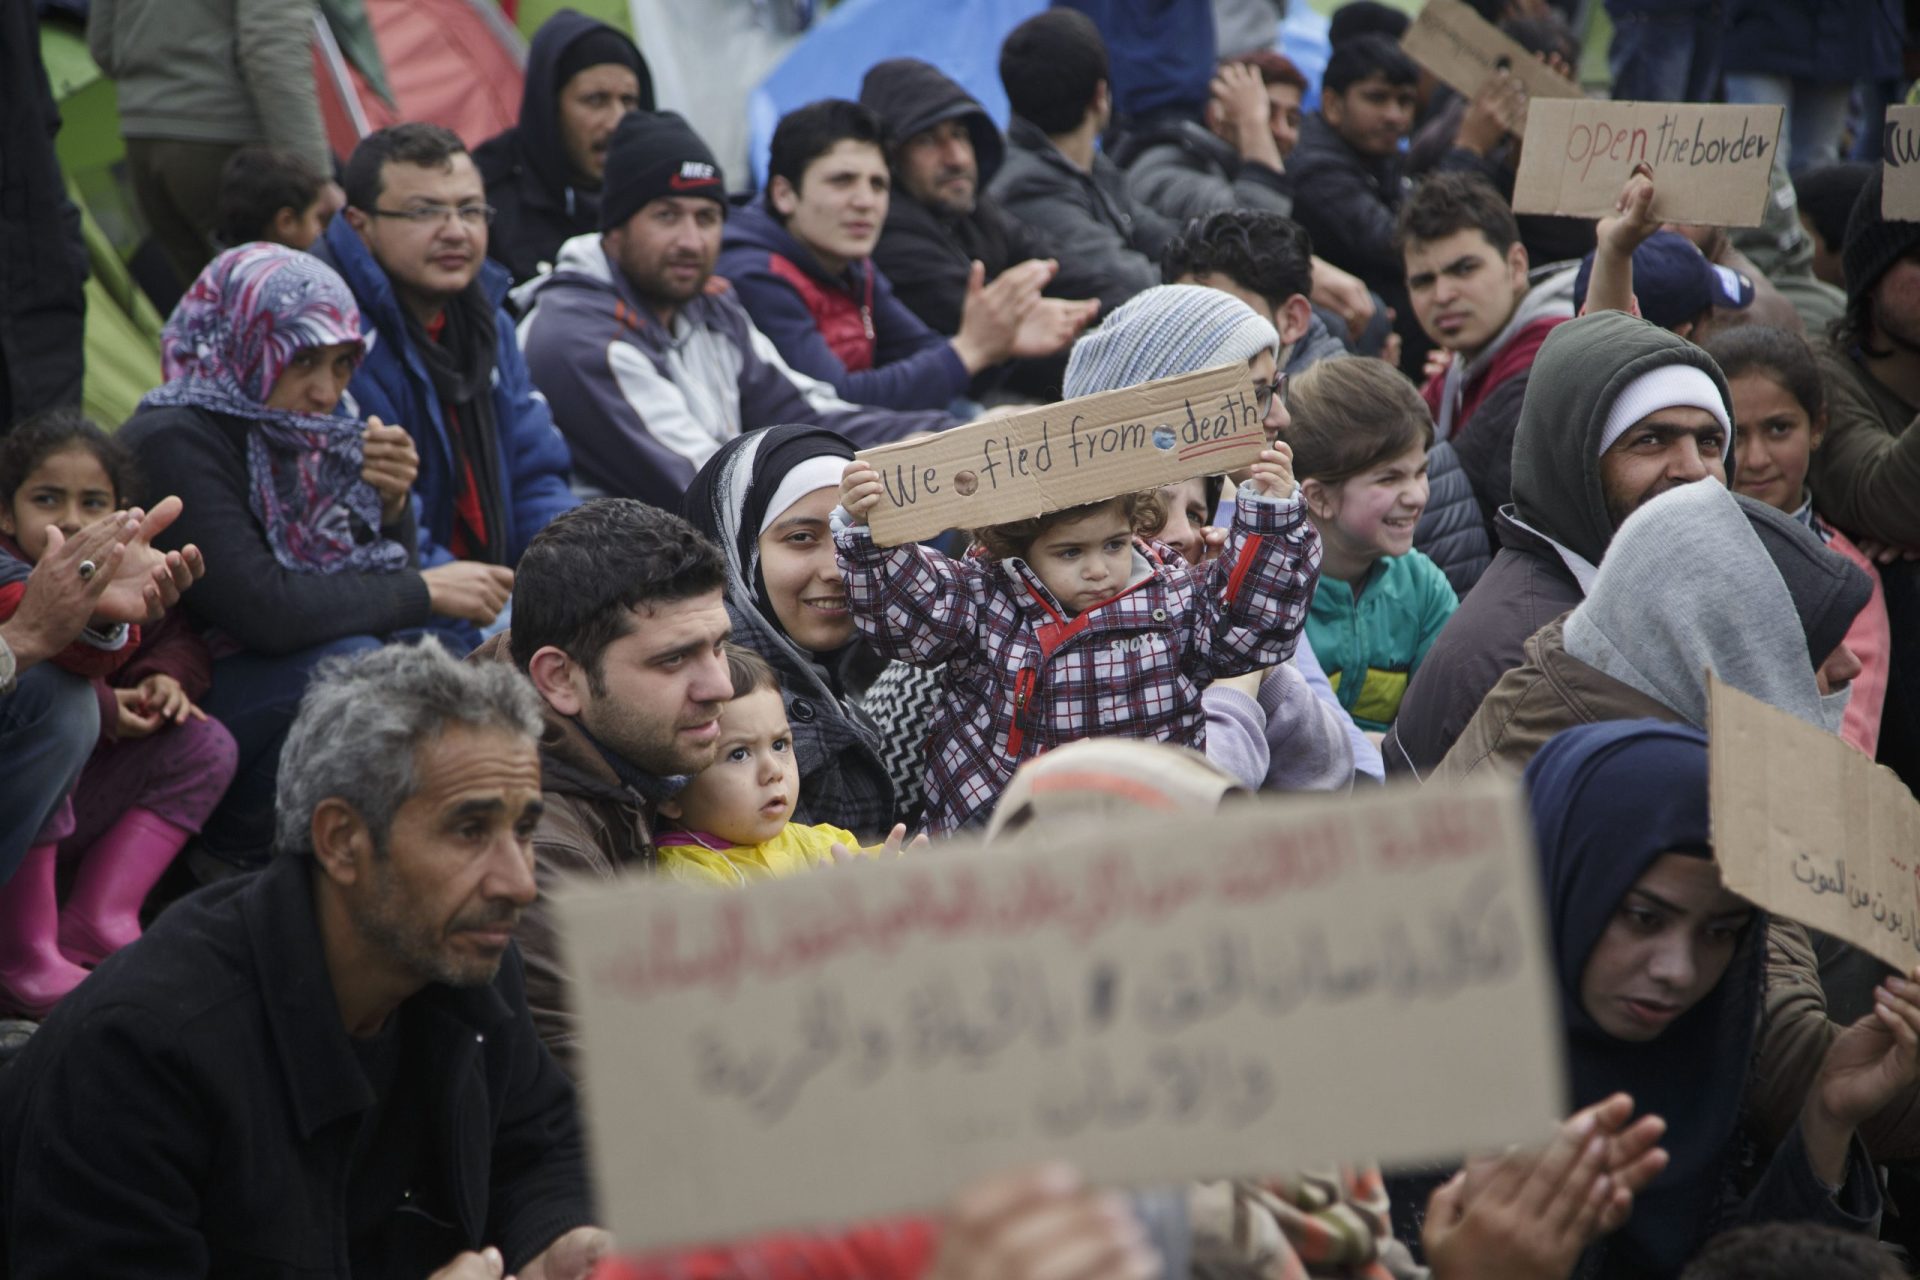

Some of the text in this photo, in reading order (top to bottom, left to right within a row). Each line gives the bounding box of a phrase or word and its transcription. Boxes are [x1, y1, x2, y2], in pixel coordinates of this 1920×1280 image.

[1567, 121, 1648, 182] open
[882, 391, 1258, 507] We fled from death
